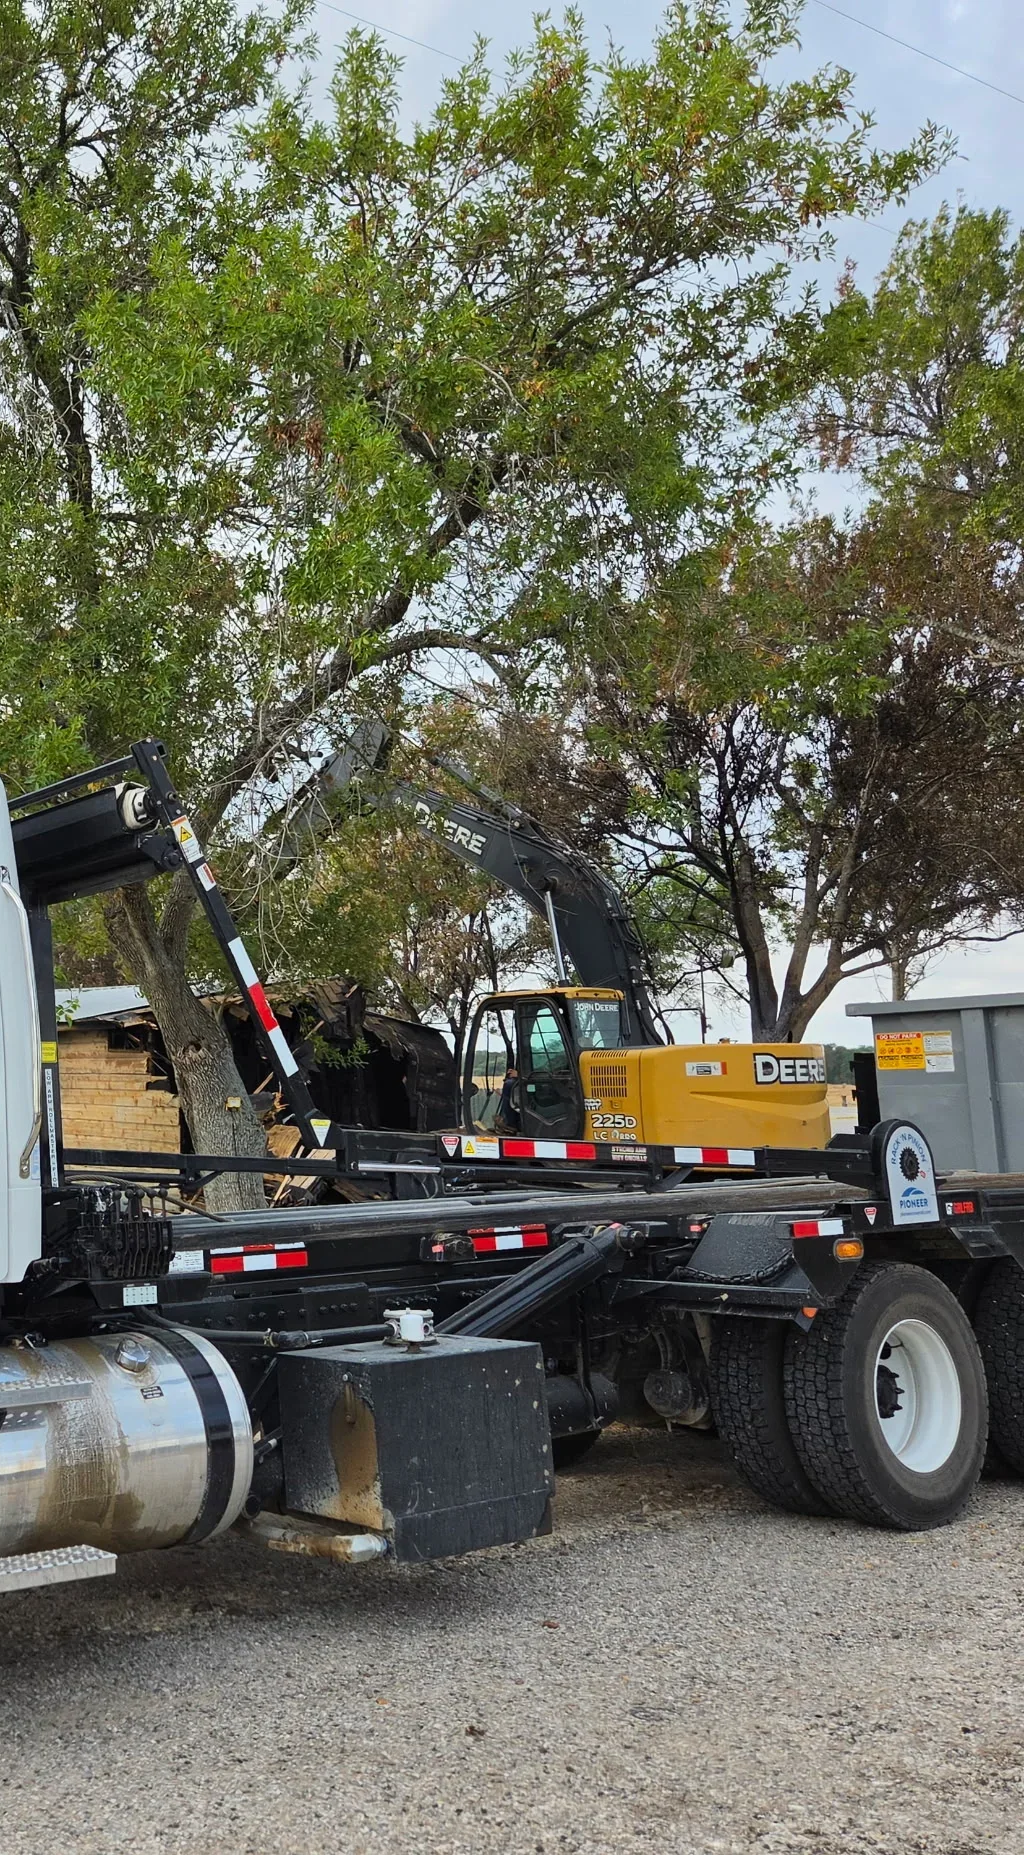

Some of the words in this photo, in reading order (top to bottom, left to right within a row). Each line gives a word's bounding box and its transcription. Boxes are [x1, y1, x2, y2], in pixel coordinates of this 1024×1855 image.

[574, 1002, 594, 1011] JOHN
[595, 1003, 619, 1012] DEERE
[591, 1113, 637, 1129] 225D
[593, 1131, 608, 1140] LC
[890, 1138, 901, 1165] RACK
[907, 1133, 927, 1162] PINION
[899, 1198, 929, 1209] PIONEER
